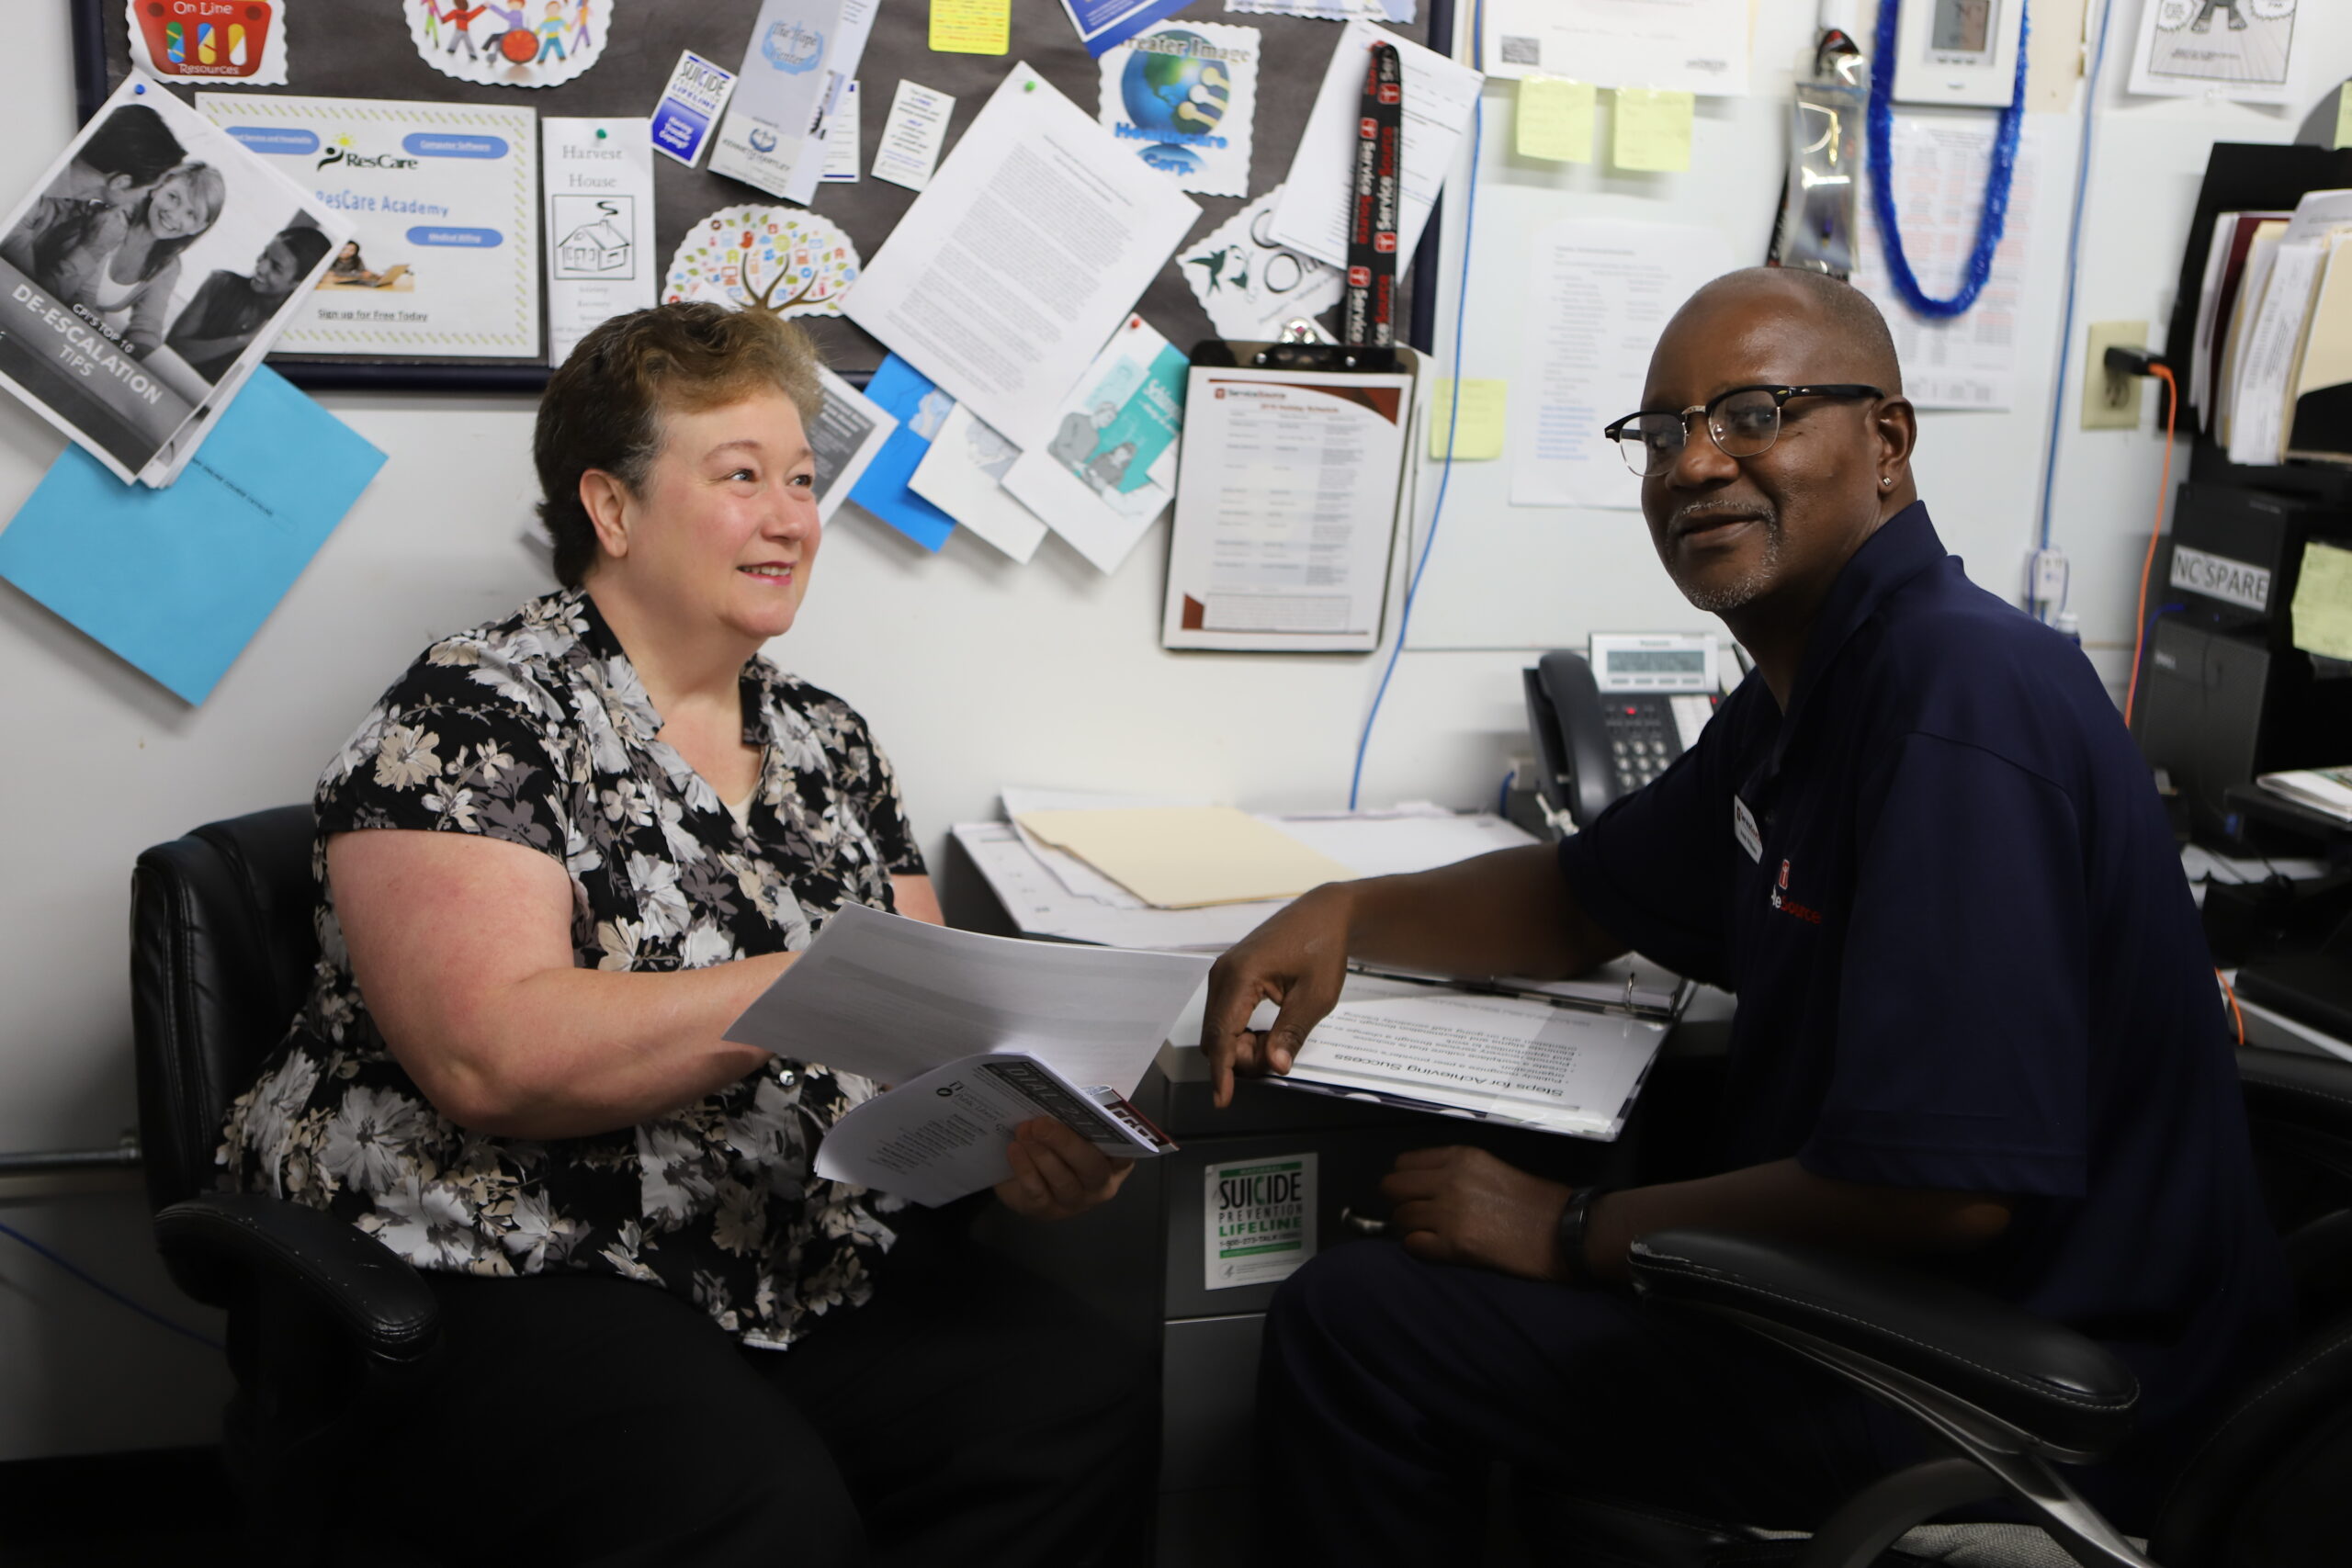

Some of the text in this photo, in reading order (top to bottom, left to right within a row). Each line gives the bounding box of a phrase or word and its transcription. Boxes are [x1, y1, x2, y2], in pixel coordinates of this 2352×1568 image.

[174, 2, 233, 16] On Line
[1190, 38, 1250, 62] Image
[178, 63, 241, 75] Resources
[680, 61, 728, 93] SUICIDE
[1114, 121, 1228, 149] Healthcare
[346, 152, 418, 170] ResCare
[562, 145, 623, 160] Harvest
[568, 173, 617, 188] House
[1358, 141, 1376, 244] ServiceSource
[1376, 127, 1394, 231] ServiceSource
[381, 196, 449, 218] Academy
[317, 309, 428, 322] Sign up for Free Today
[12, 283, 163, 405] DE-ESCALATION
[97, 322, 120, 342] TOP
[119, 340, 136, 355] 10
[59, 344, 95, 377] TIPS
[2174, 554, 2270, 603] NC SPARE
[1004, 1067, 1059, 1100] DIAL
[1334, 1054, 1563, 1097] Steps for Achieving Success
[1219, 1171, 1303, 1211] SUICIDE
[1219, 1202, 1303, 1224] PREVENTION
[1219, 1216, 1303, 1238] LIFELINE
